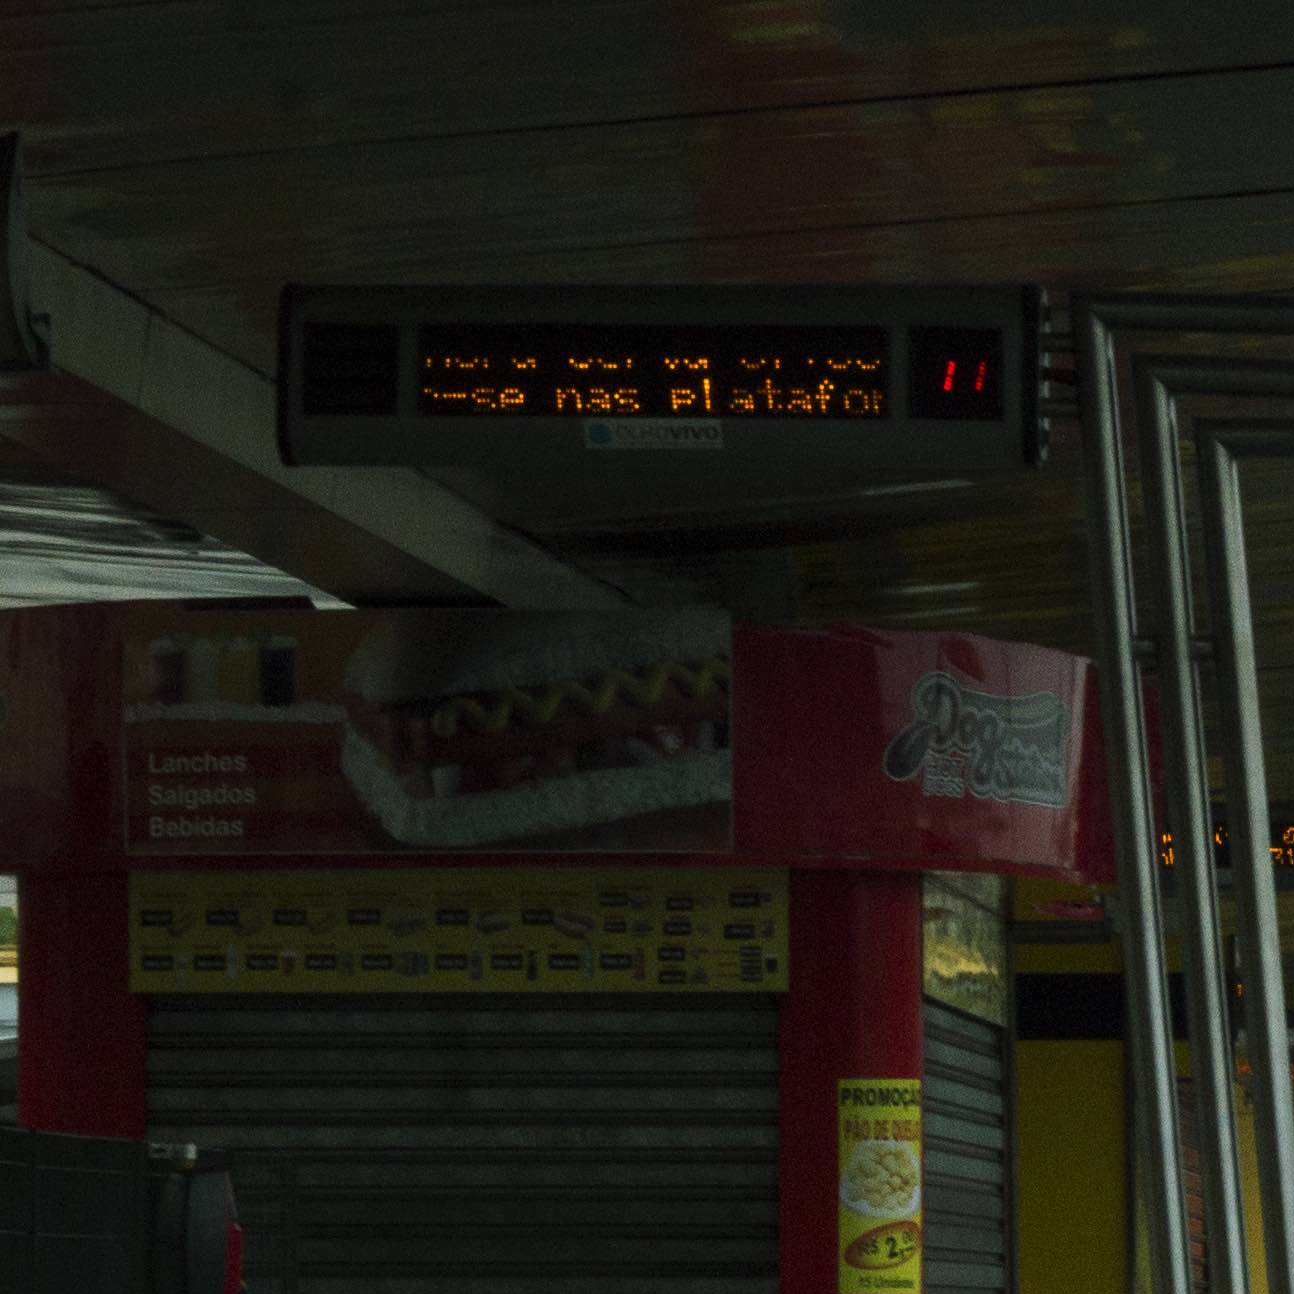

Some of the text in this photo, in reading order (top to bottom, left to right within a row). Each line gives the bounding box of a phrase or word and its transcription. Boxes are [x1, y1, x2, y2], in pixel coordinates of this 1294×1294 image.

[941, 357, 989, 394] 11
[554, 386, 641, 412] nas
[147, 752, 247, 773] Lanches
[148, 785, 257, 809] Salgados
[149, 816, 243, 837] Bebidas
